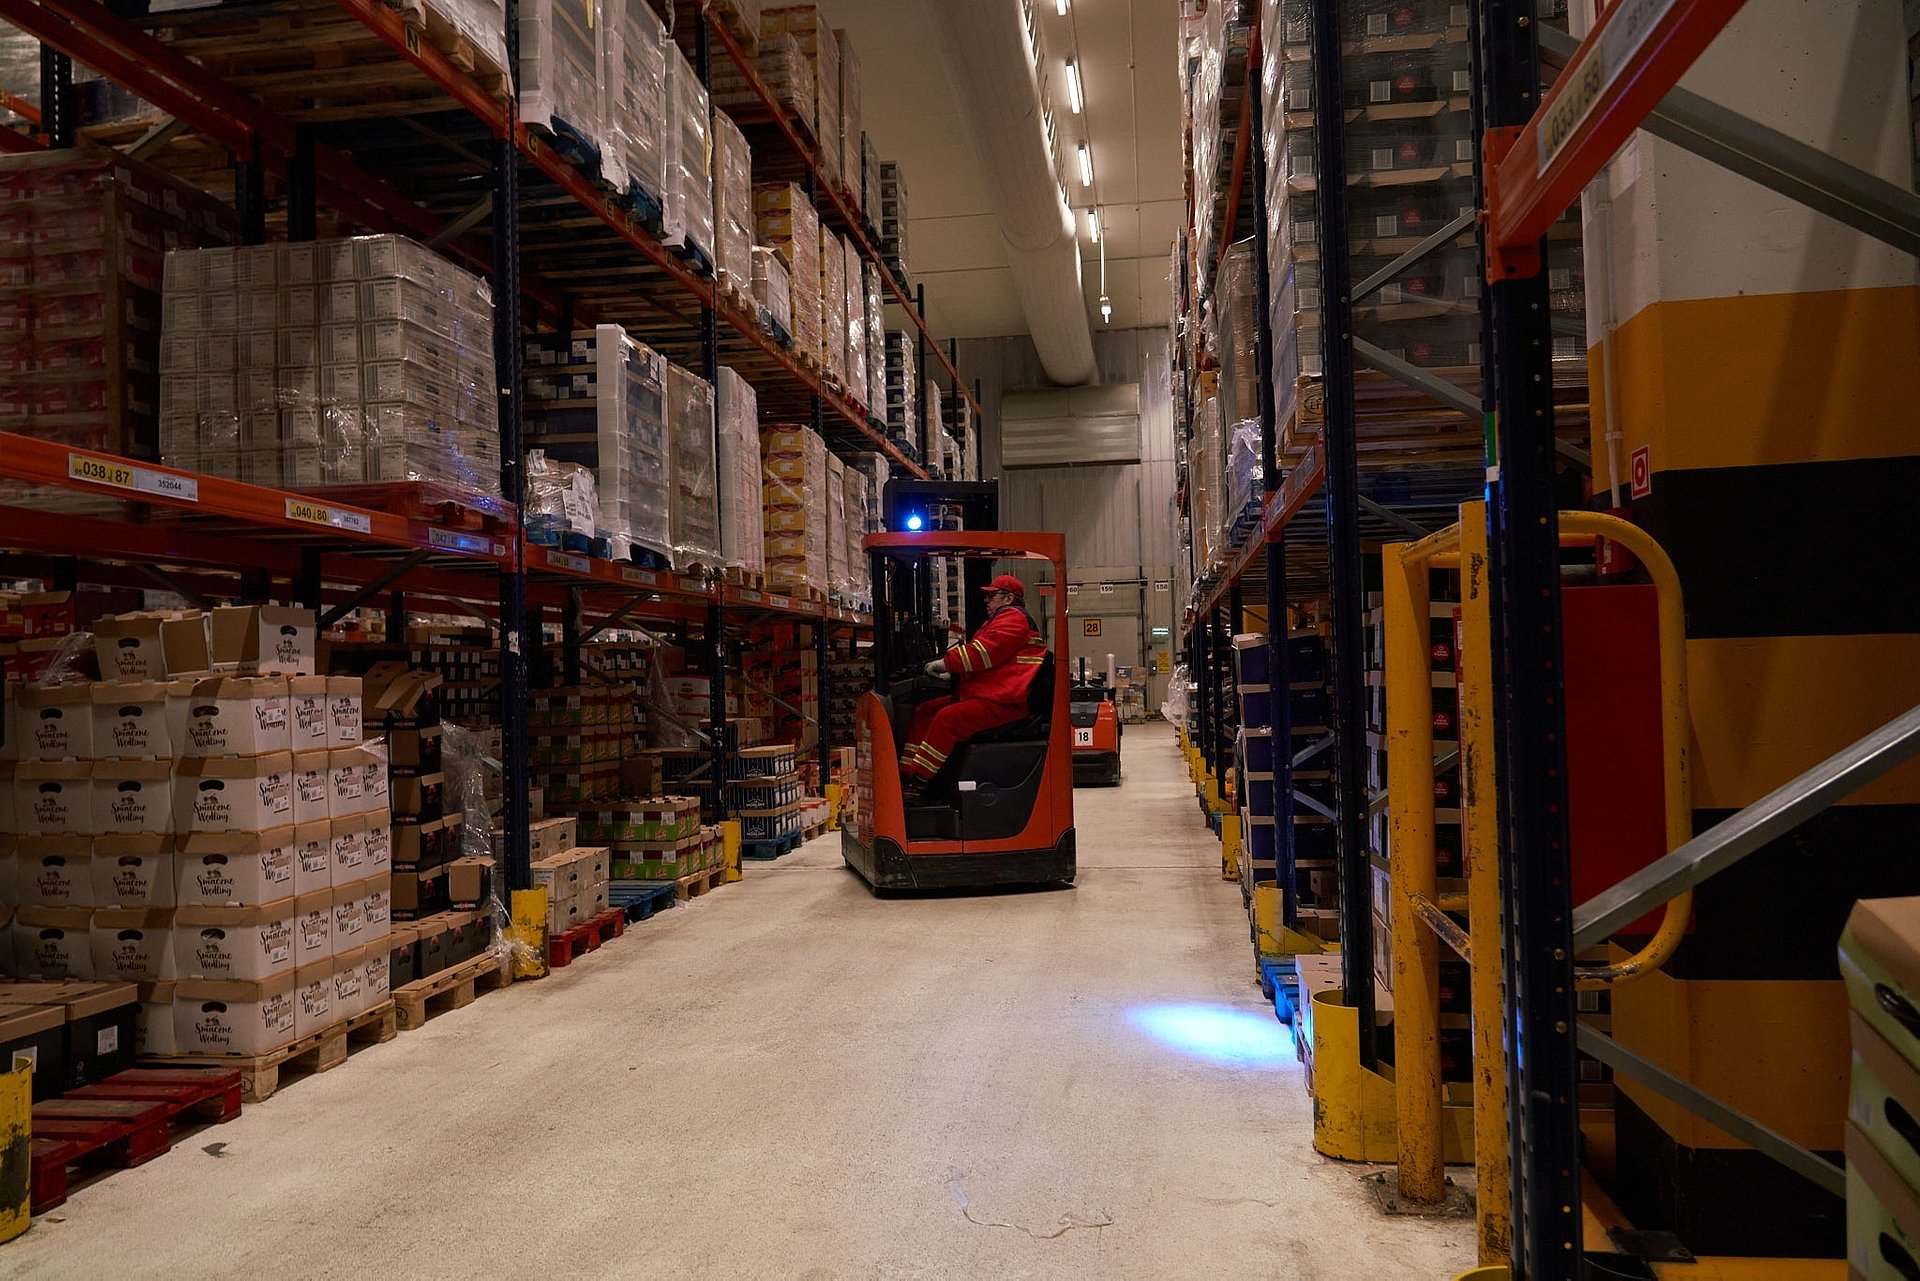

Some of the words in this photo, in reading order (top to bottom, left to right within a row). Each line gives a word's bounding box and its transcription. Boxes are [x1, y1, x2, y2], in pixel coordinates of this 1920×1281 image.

[408, 26, 418, 54] N
[83, 461, 106, 479] 038
[115, 469, 129, 484] 87
[296, 505, 312, 519] 040
[317, 509, 327, 522] 80
[1087, 623, 1098, 632] 28
[1078, 732, 1089, 742] 18
